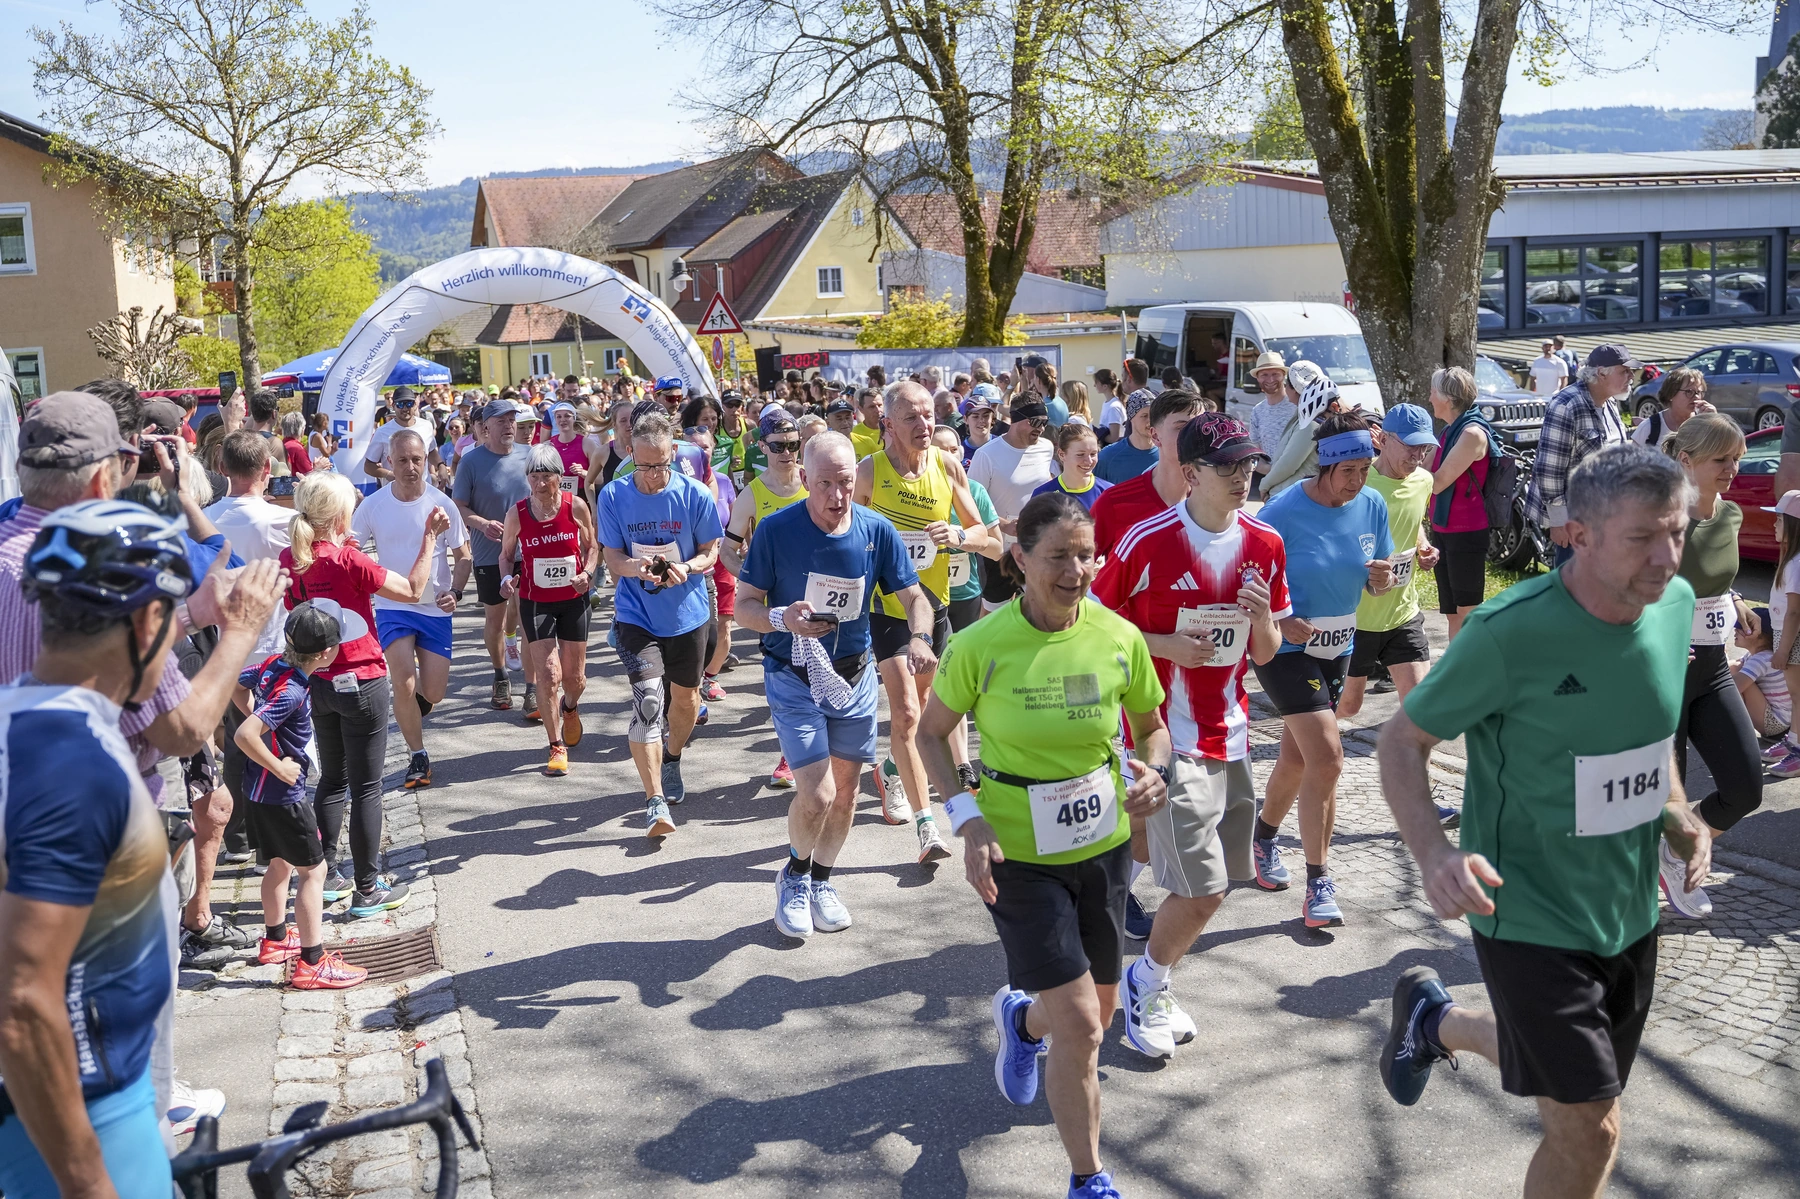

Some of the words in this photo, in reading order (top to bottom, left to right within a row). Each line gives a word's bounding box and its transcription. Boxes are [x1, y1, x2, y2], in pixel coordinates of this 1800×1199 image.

[441, 266, 495, 292] Herzlich
[498, 263, 588, 287] willkommen!
[655, 316, 687, 355] Volksbank
[346, 322, 400, 415] Allgäu-Oberschwaben
[399, 311, 412, 325] eG
[781, 352, 829, 369] 15:00:27
[335, 365, 356, 413] Volksbank
[898, 490, 918, 500] POLDI
[919, 496, 938, 505] SPORT
[912, 502, 933, 510] Waldsee
[627, 522, 657, 533] NIGHT
[660, 521, 682, 530] RUN
[526, 538, 540, 547] LG
[541, 532, 575, 544] Welfen
[905, 545, 926, 559] 12
[544, 567, 567, 578] 429
[1392, 561, 1412, 575] 475
[826, 591, 849, 608] 28
[1706, 611, 1725, 630] 35
[1012, 686, 1062, 694] Halbmarathon
[1554, 686, 1588, 696] adidas
[1067, 708, 1102, 720] 2014
[1602, 767, 1660, 803] 1184
[1056, 794, 1102, 827] 469
[1075, 824, 1091, 833] Jutta
[1072, 834, 1089, 845] AOK
